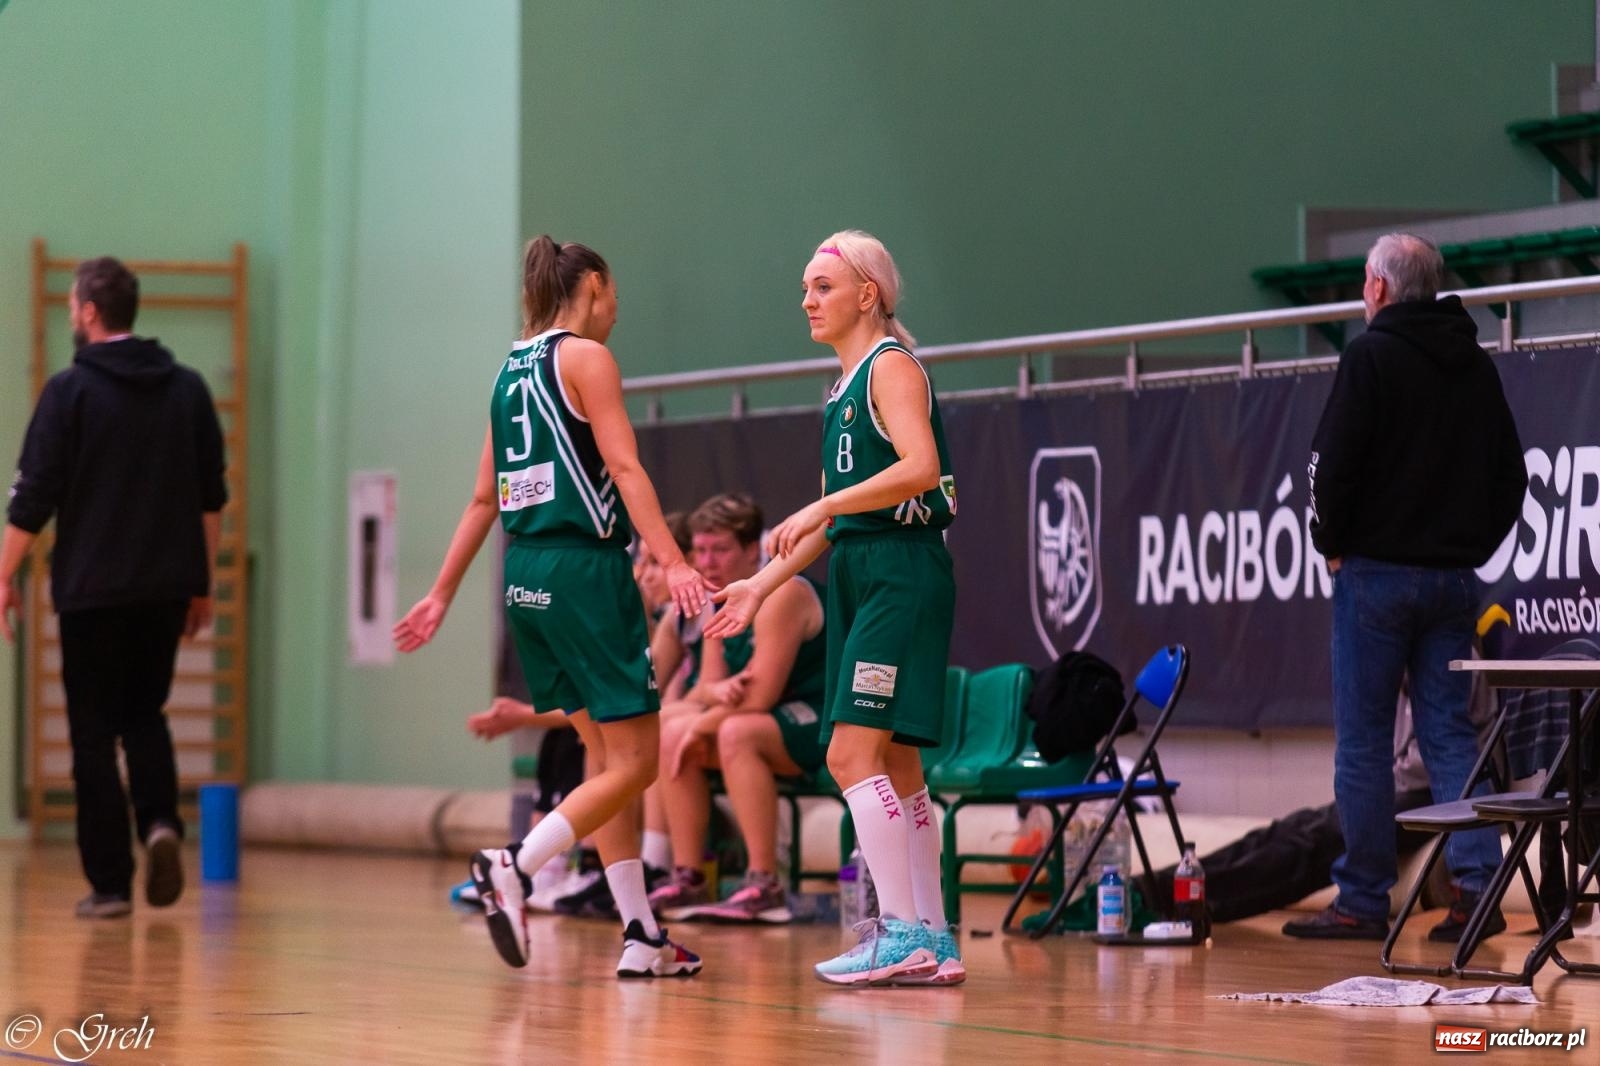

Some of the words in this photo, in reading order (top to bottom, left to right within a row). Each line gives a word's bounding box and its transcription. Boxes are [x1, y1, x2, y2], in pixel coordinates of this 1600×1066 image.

[506, 376, 532, 462] 3
[836, 433, 854, 473] 8
[514, 586, 552, 605] Clavis
[854, 699, 886, 709] COLO
